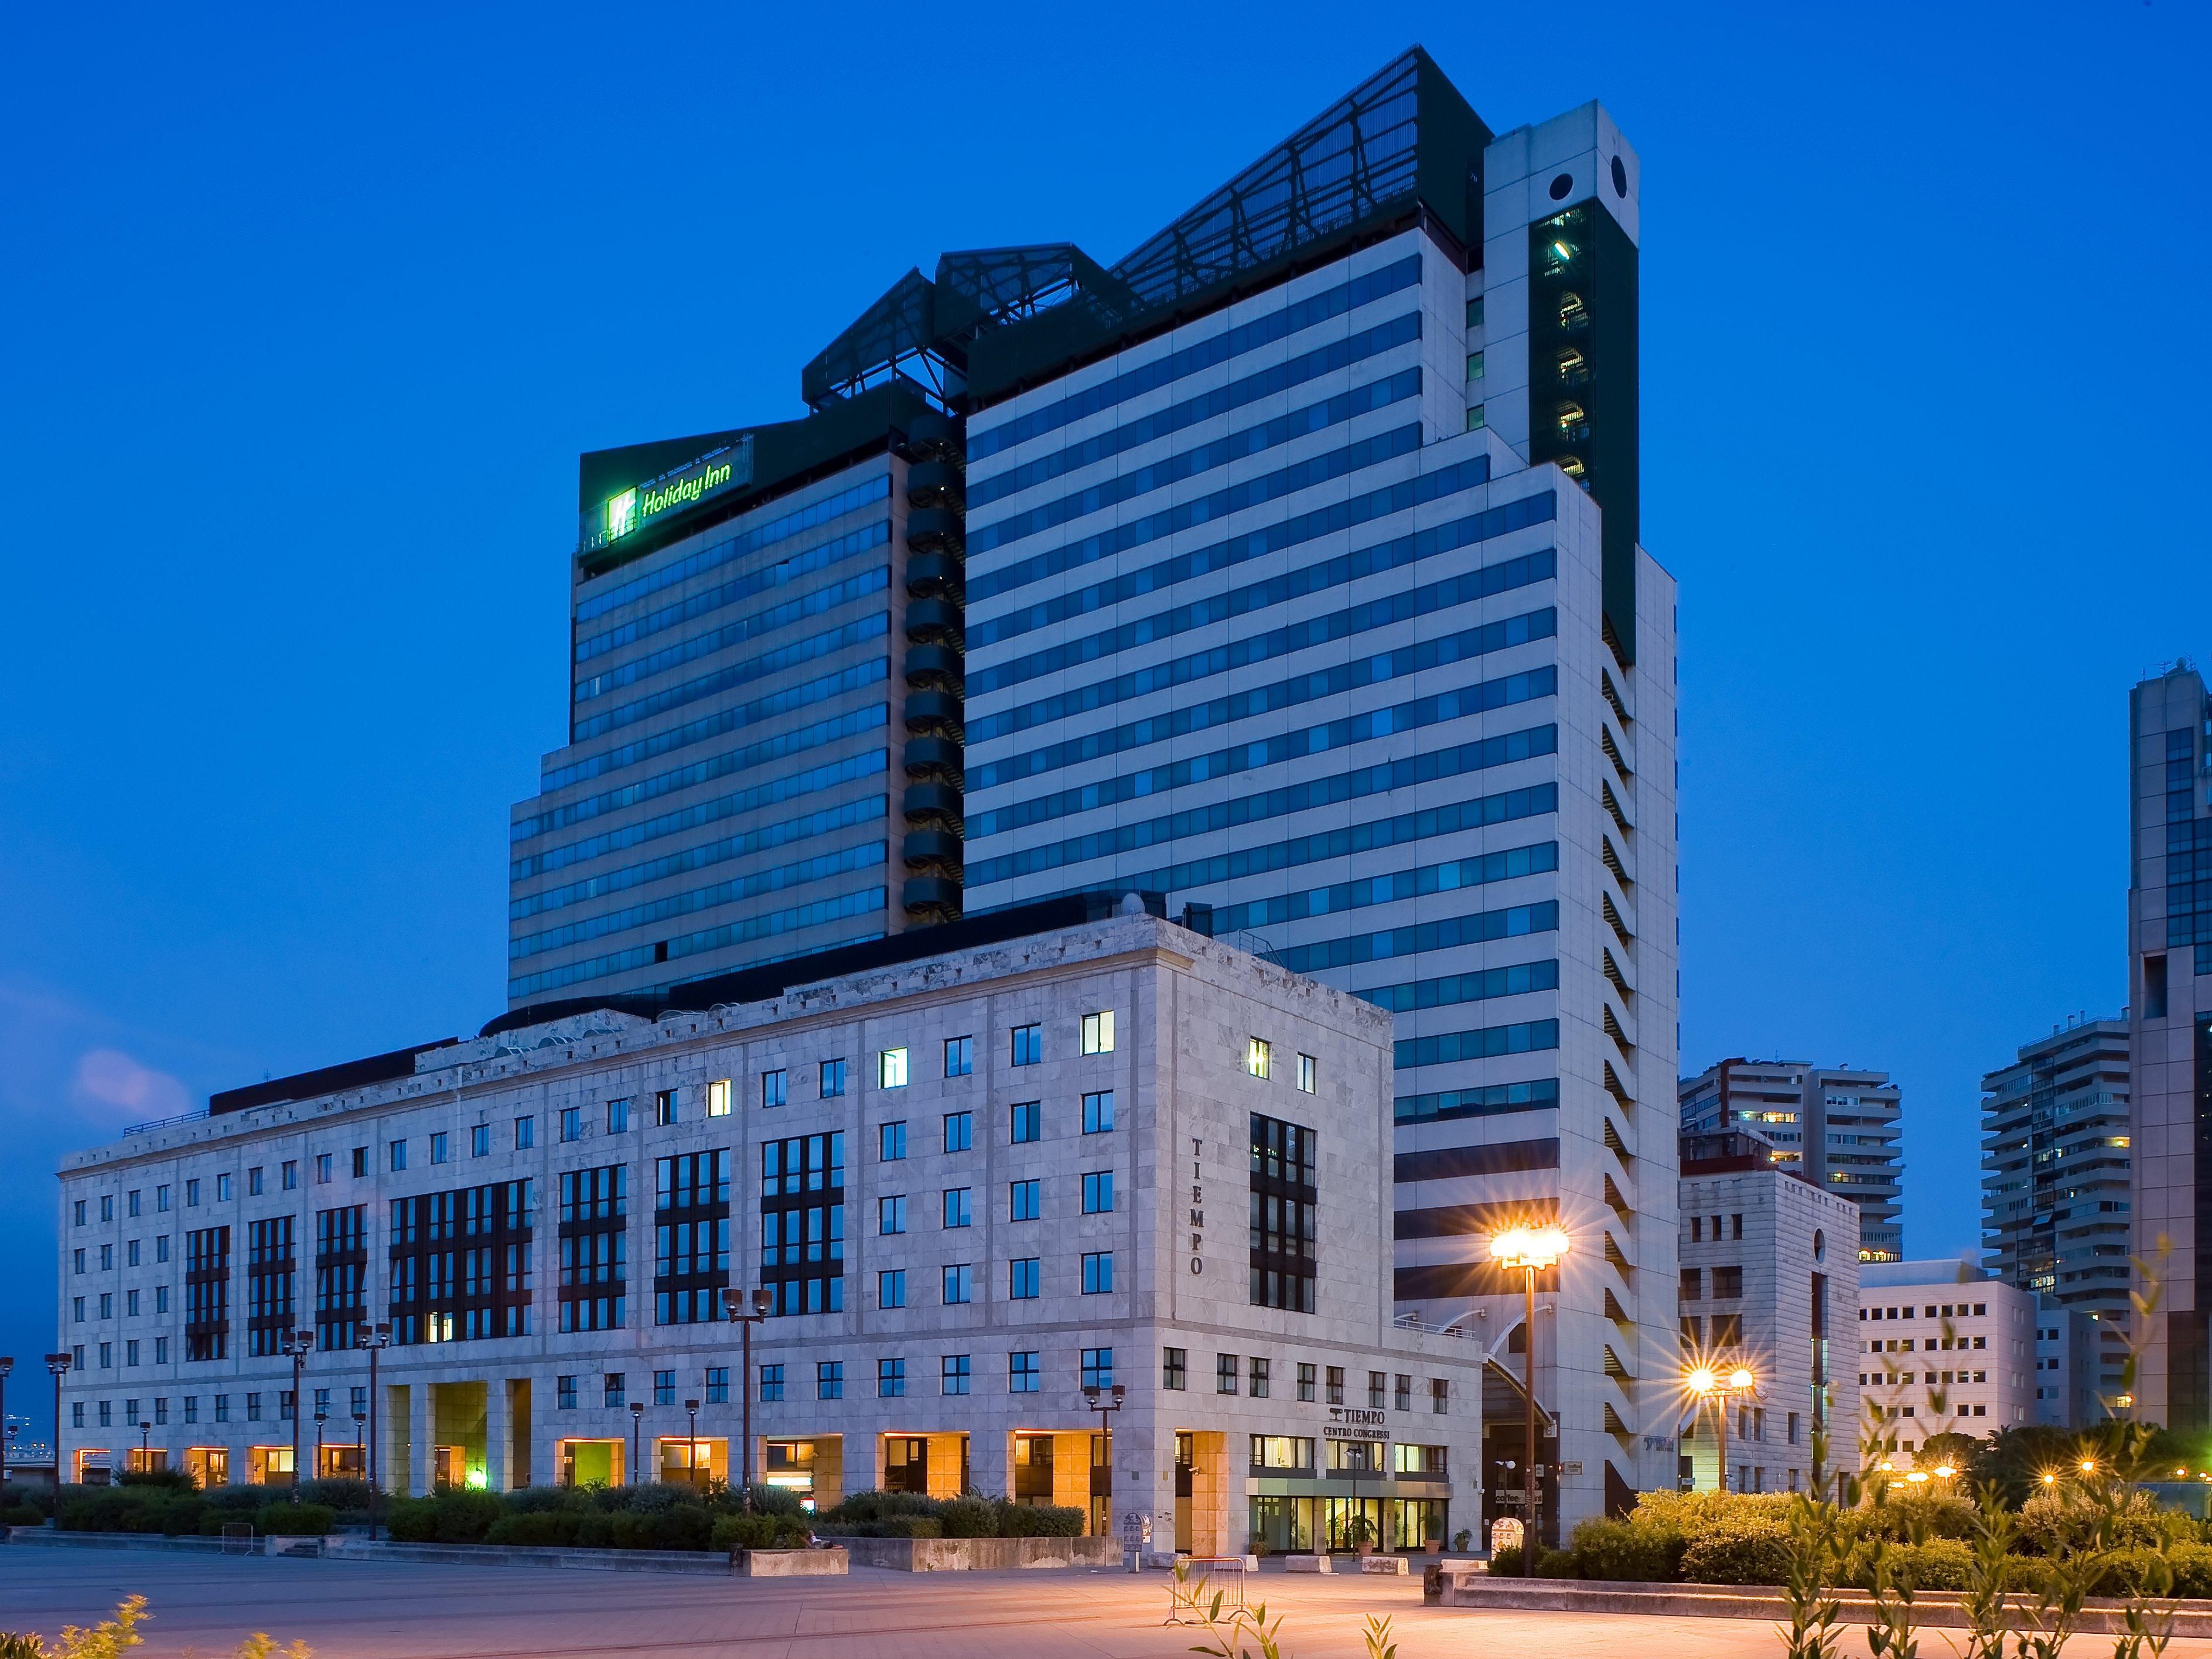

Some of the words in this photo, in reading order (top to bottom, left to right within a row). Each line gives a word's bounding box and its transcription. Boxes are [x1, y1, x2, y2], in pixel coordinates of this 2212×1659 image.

[642, 477, 702, 517] Holiday
[704, 464, 730, 490] Inn
[1190, 1138, 1204, 1275] TIEMPO
[1323, 1426, 1352, 1437] CENTRO
[1353, 1428, 1390, 1439] CONGRESSI
[1344, 1409, 1385, 1424] TIEMPO
